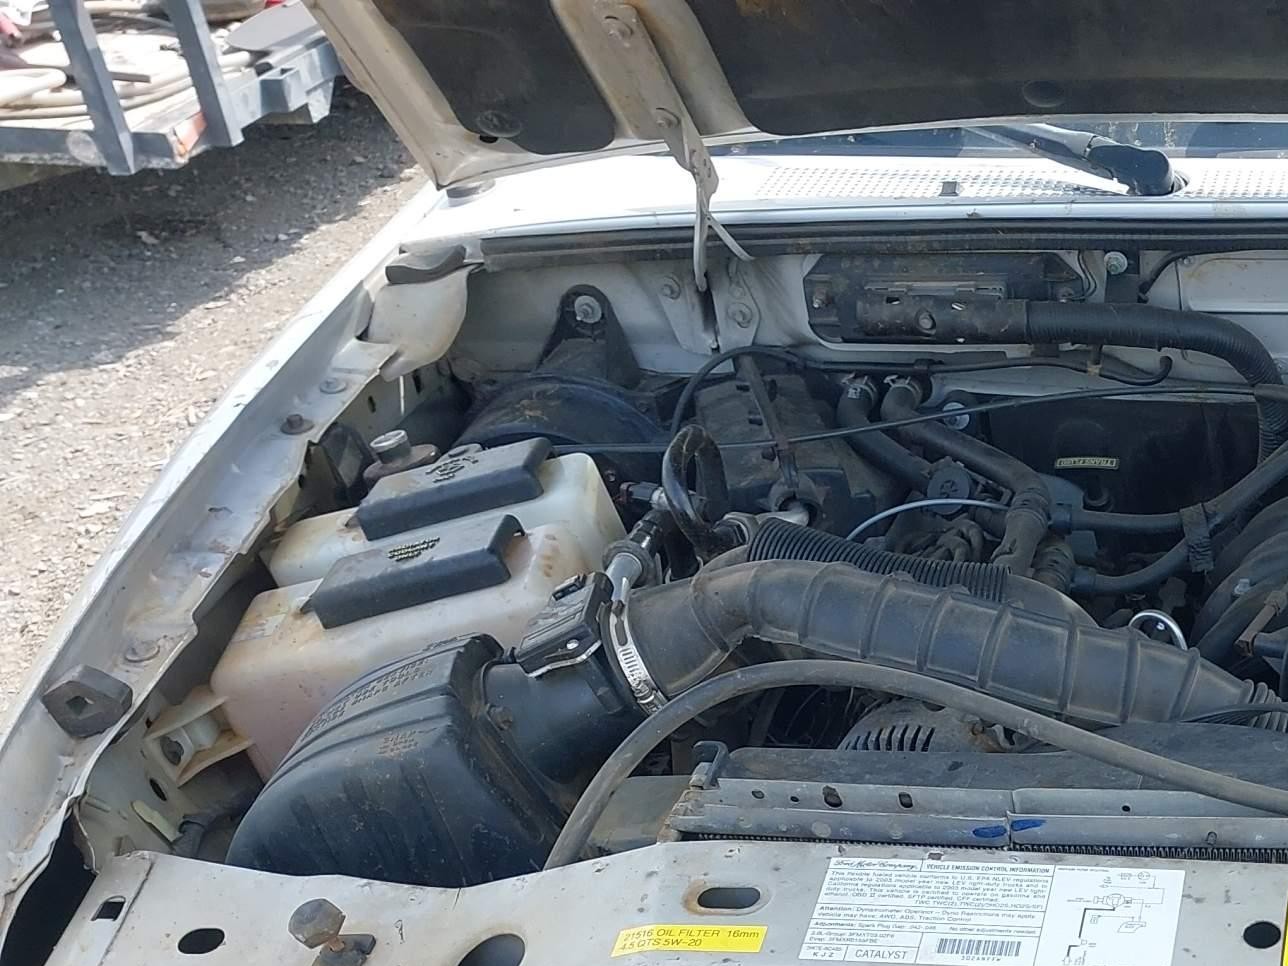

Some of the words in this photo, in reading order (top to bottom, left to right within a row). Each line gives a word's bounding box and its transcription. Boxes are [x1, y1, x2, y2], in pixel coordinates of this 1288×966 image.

[1008, 866, 1049, 874] INFORMATION
[656, 929, 675, 937] OIL
[678, 929, 720, 937] FILTER
[727, 930, 760, 938] 16mm
[637, 938, 661, 948] QTS
[663, 939, 703, 947] 5W-20
[854, 948, 907, 959] CATALYST
